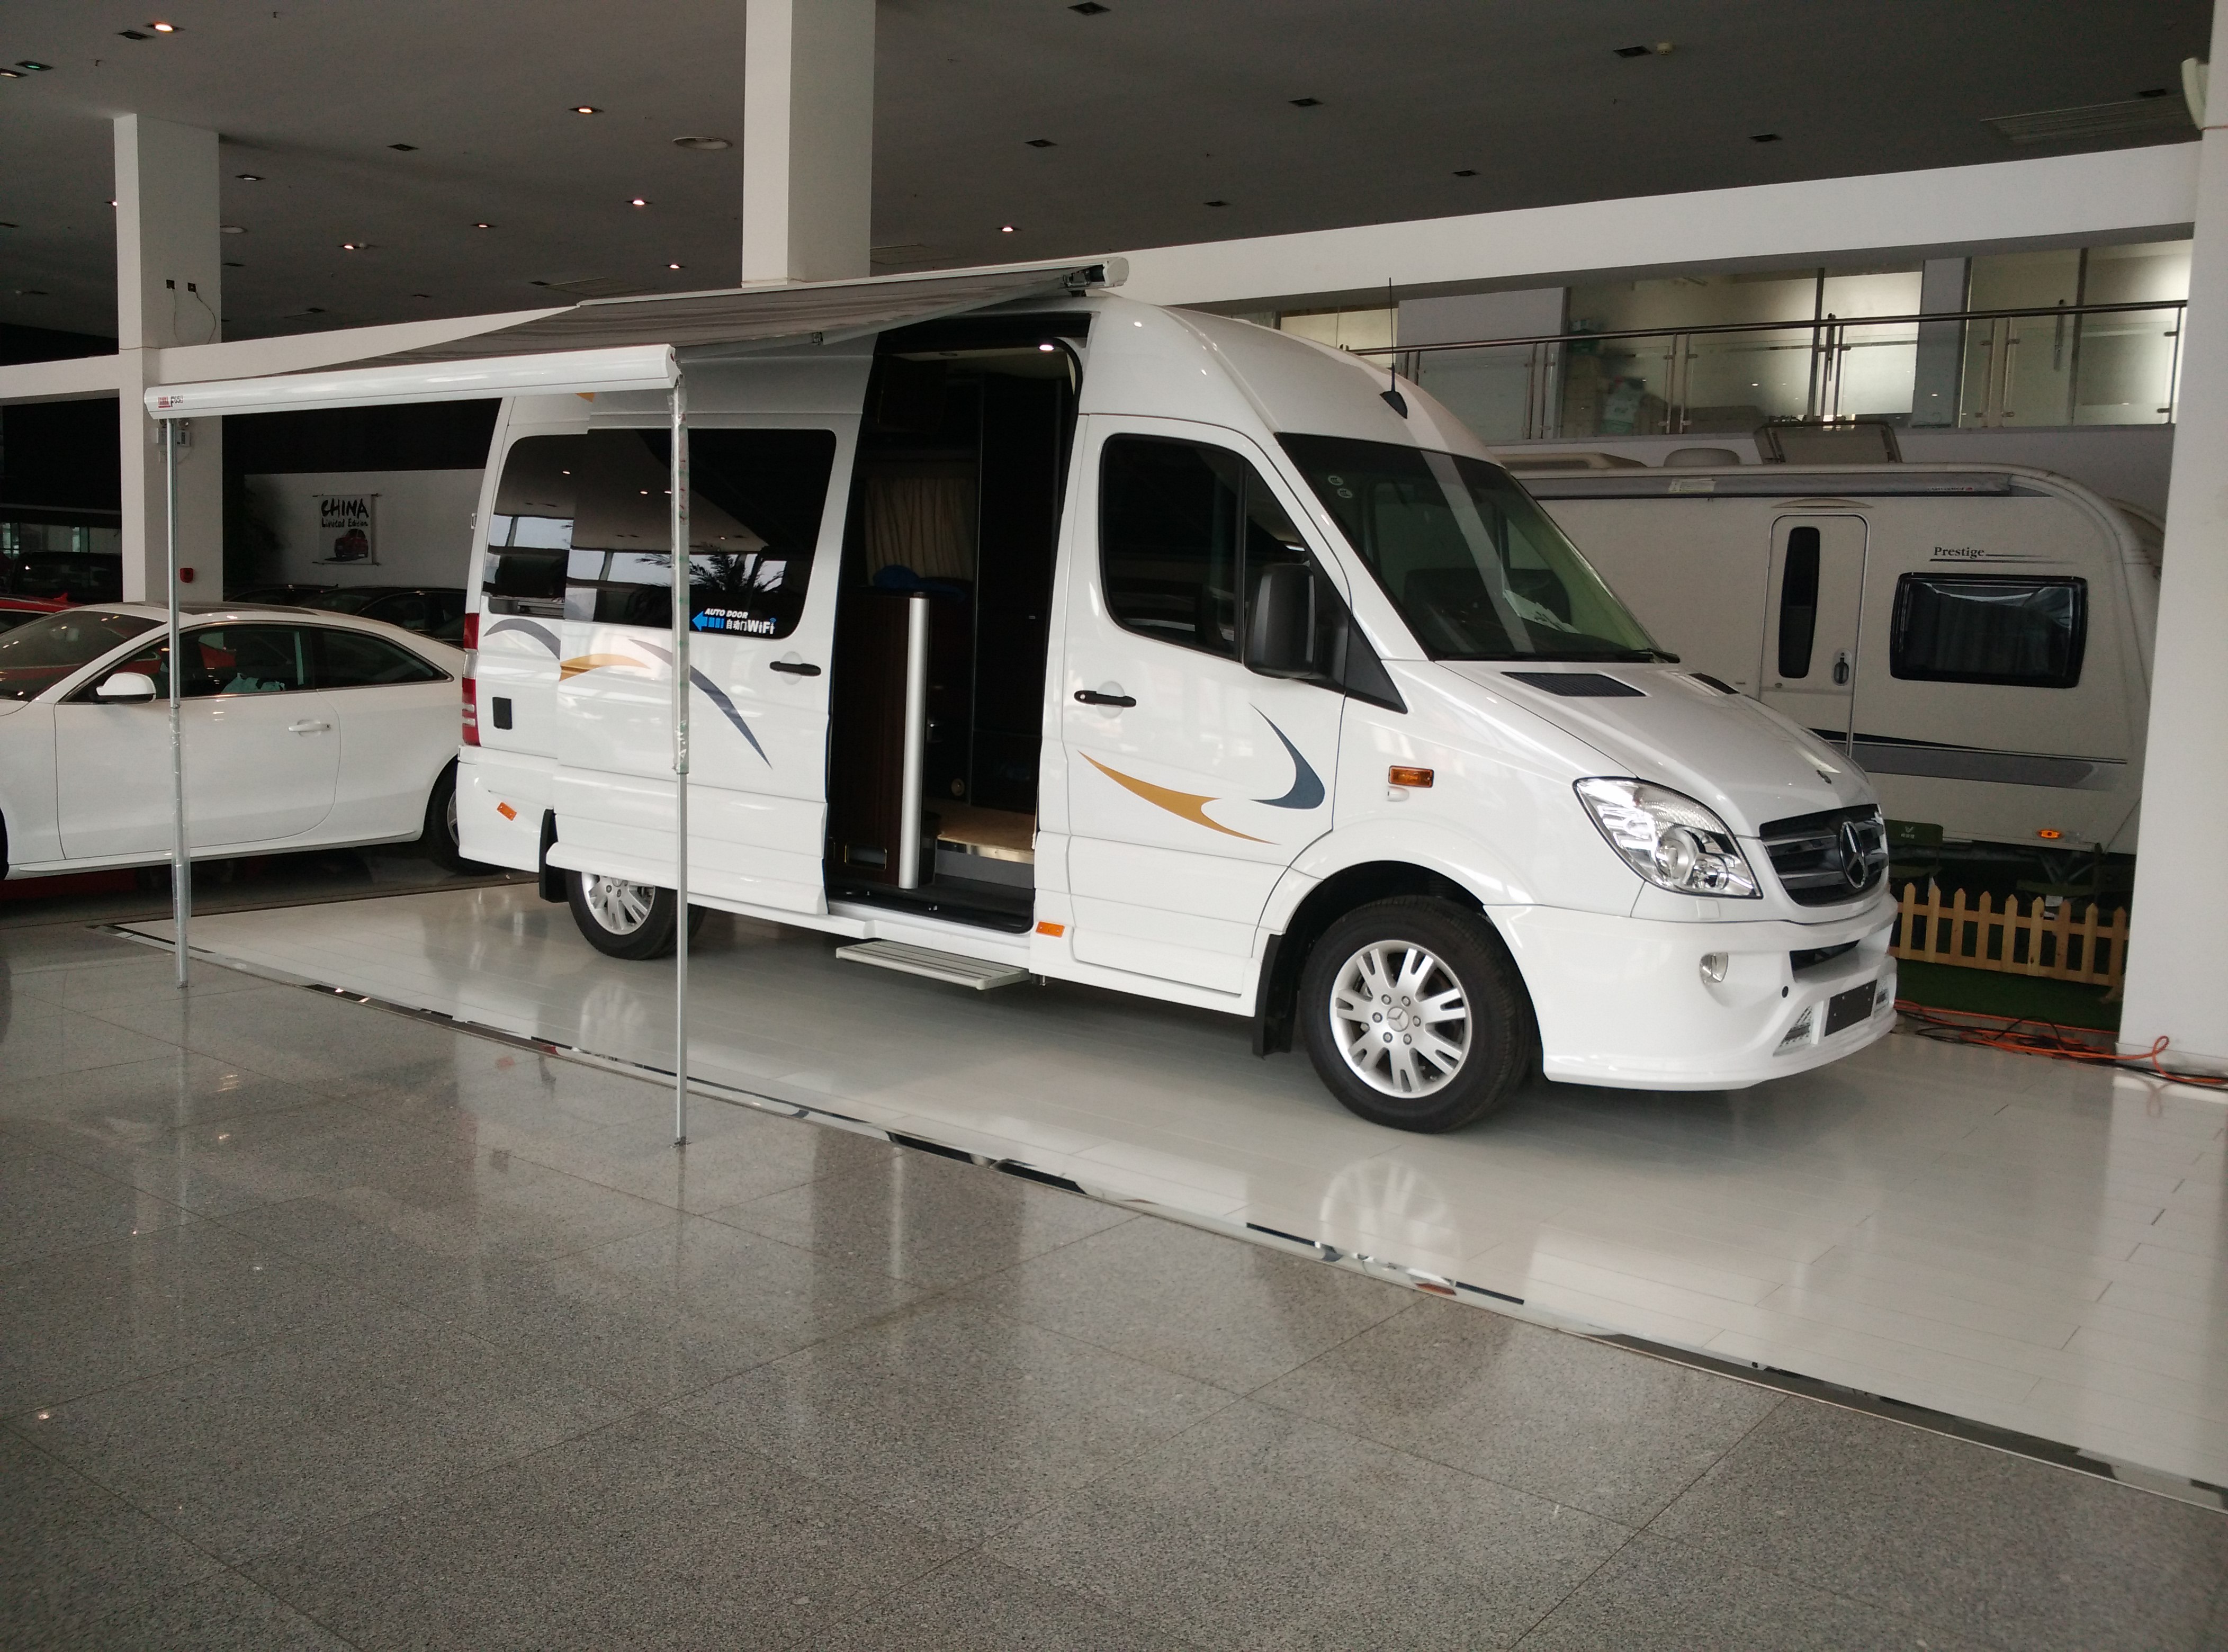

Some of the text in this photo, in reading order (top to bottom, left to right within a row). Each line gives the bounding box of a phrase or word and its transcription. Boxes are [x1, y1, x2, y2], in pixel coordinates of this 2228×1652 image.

[321, 498, 369, 518] CHINA
[322, 518, 368, 527] Limited Edition
[1934, 547, 1984, 559] Prestige
[704, 608, 749, 619] AUTO DOOR
